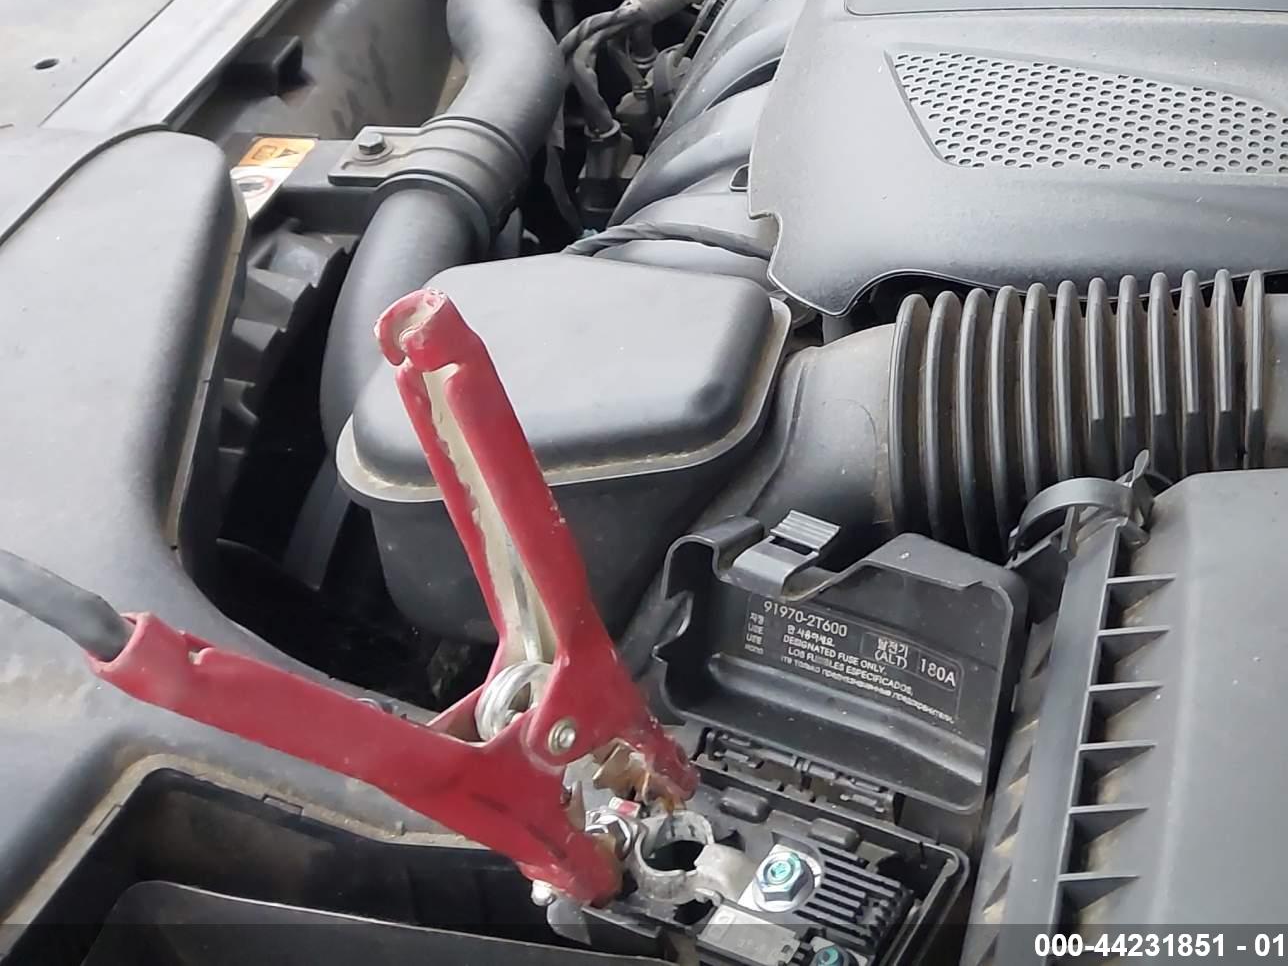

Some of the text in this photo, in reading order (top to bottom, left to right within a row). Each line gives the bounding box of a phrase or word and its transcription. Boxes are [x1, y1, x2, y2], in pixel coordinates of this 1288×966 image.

[763, 600, 848, 637] 91970-2T600
[783, 634, 837, 658] DEGNATED
[837, 651, 860, 666] FUSE
[806, 652, 845, 672] FULES
[874, 649, 908, 670] (ALT)
[919, 657, 957, 687] 180A
